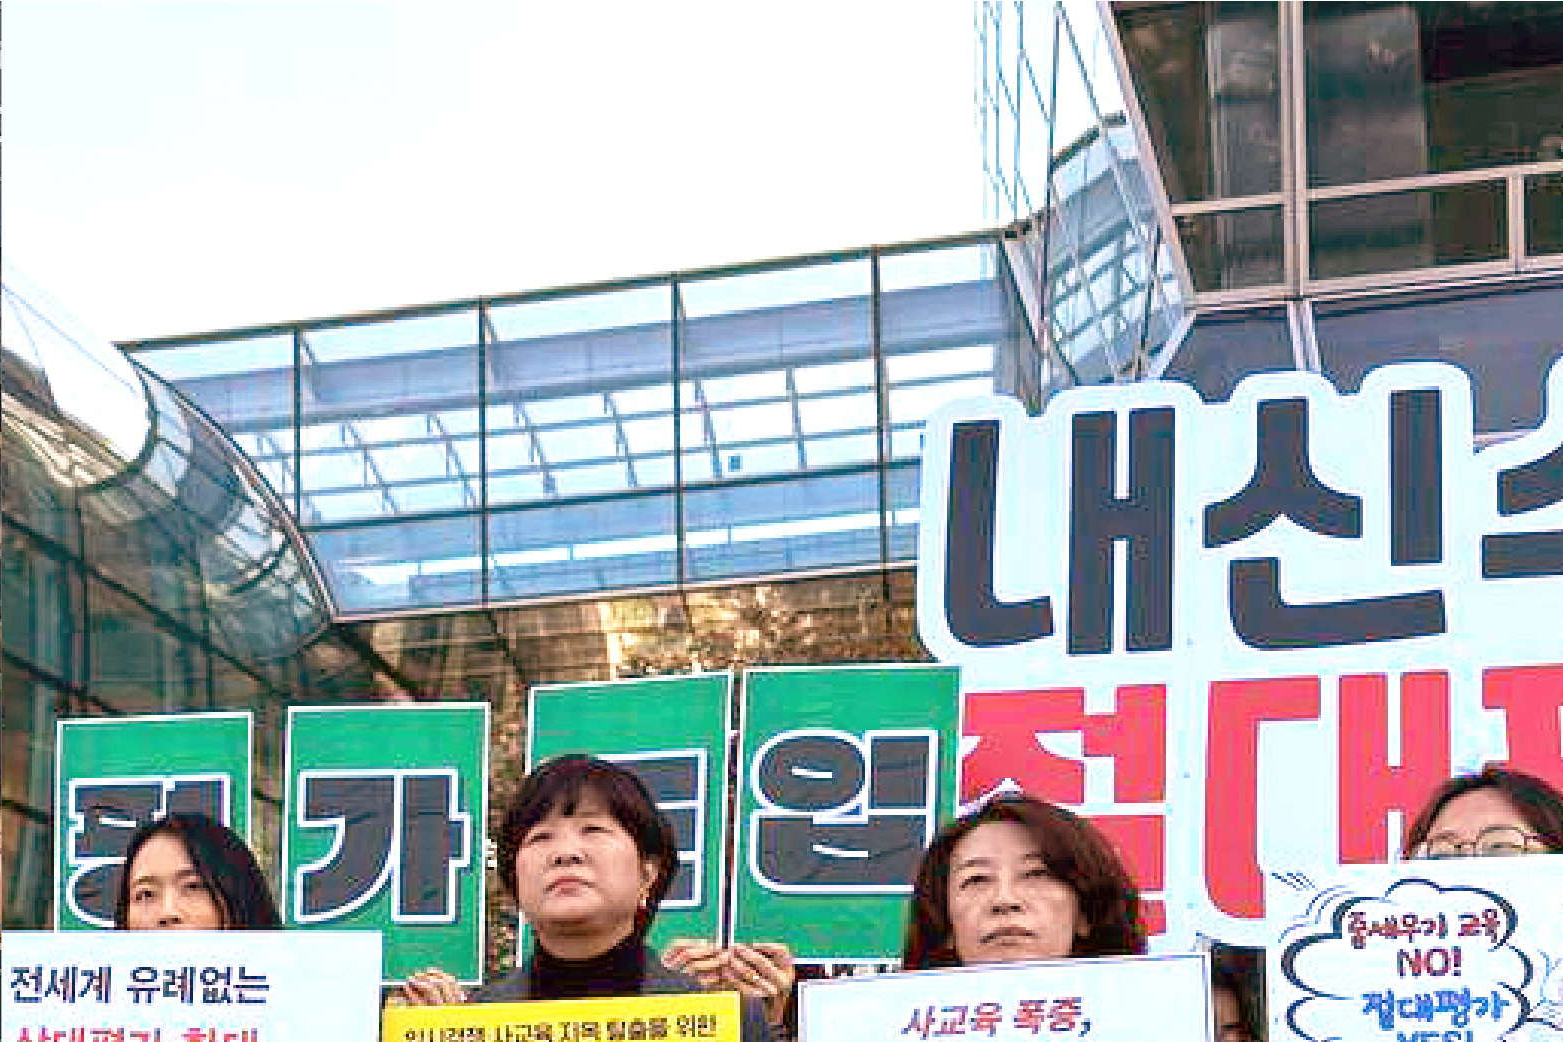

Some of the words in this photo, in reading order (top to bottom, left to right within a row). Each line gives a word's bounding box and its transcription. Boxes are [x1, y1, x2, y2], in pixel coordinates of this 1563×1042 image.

[1458, 909, 1500, 943] 교육
[1397, 946, 1462, 978] NO!
[10, 966, 111, 1004] 전세계
[127, 966, 269, 1005] 유례없는
[676, 1014, 716, 1037] 위한
[901, 1003, 1002, 1039] 사교육
[1361, 987, 1511, 1031] 절대평가
